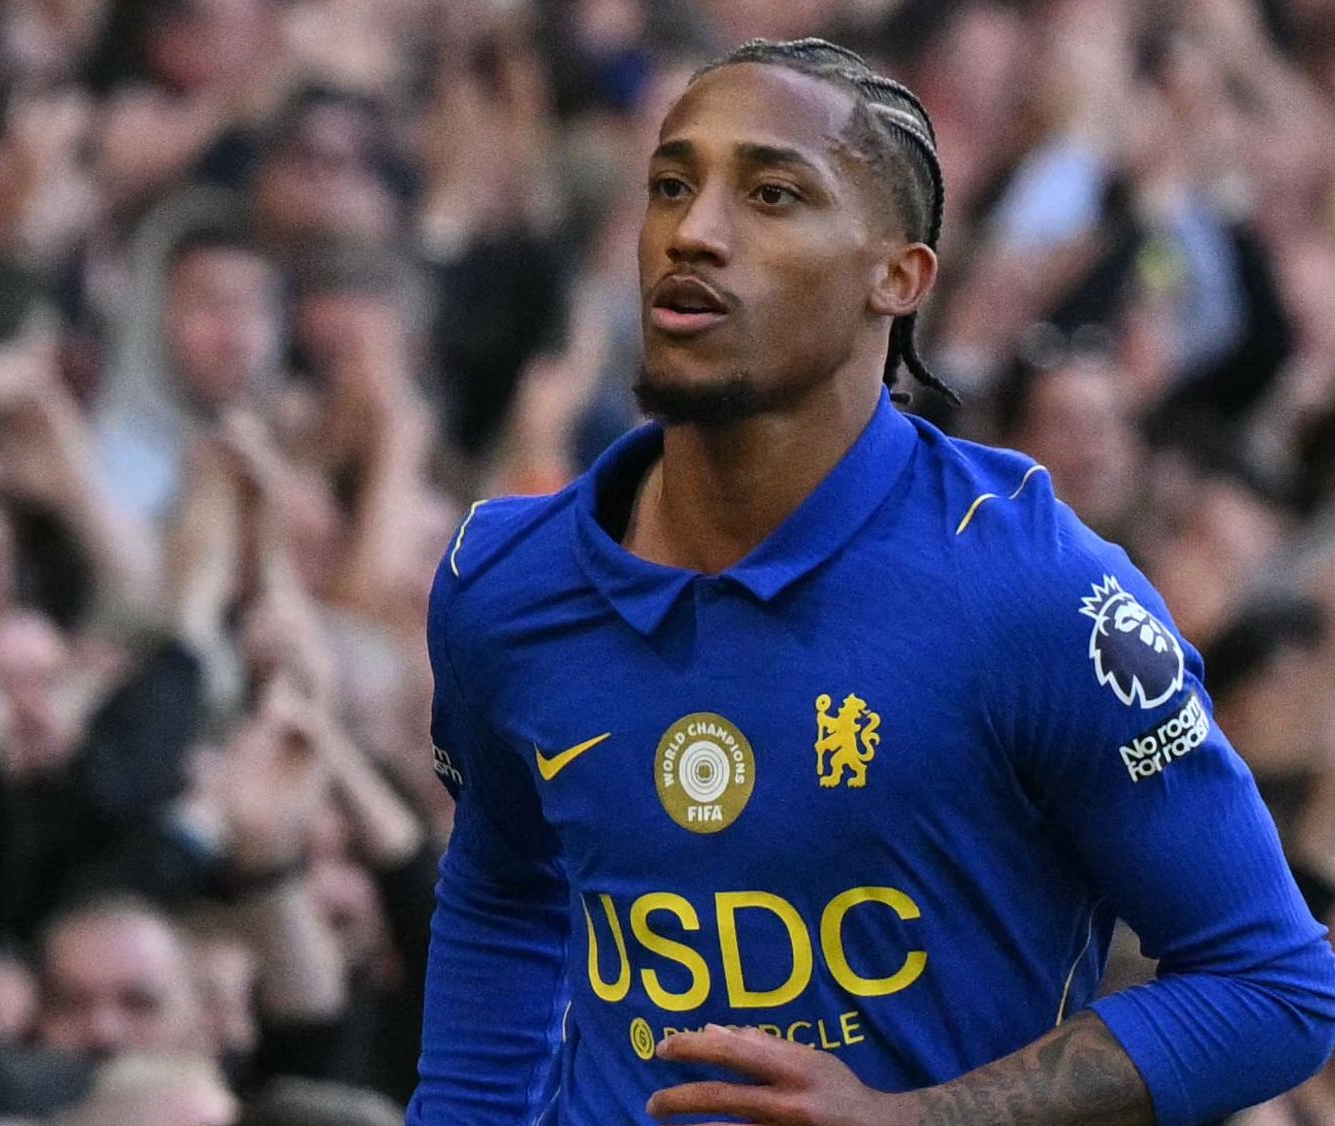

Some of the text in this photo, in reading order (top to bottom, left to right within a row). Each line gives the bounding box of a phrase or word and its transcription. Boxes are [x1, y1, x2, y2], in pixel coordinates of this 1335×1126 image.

[663, 722, 746, 788] WORLD CHAMPIONS
[1119, 695, 1202, 766] No room
[1126, 752, 1163, 784] for
[687, 804, 723, 822] FIFA
[580, 885, 929, 1012] USDC
[724, 1010, 865, 1050] CLE
